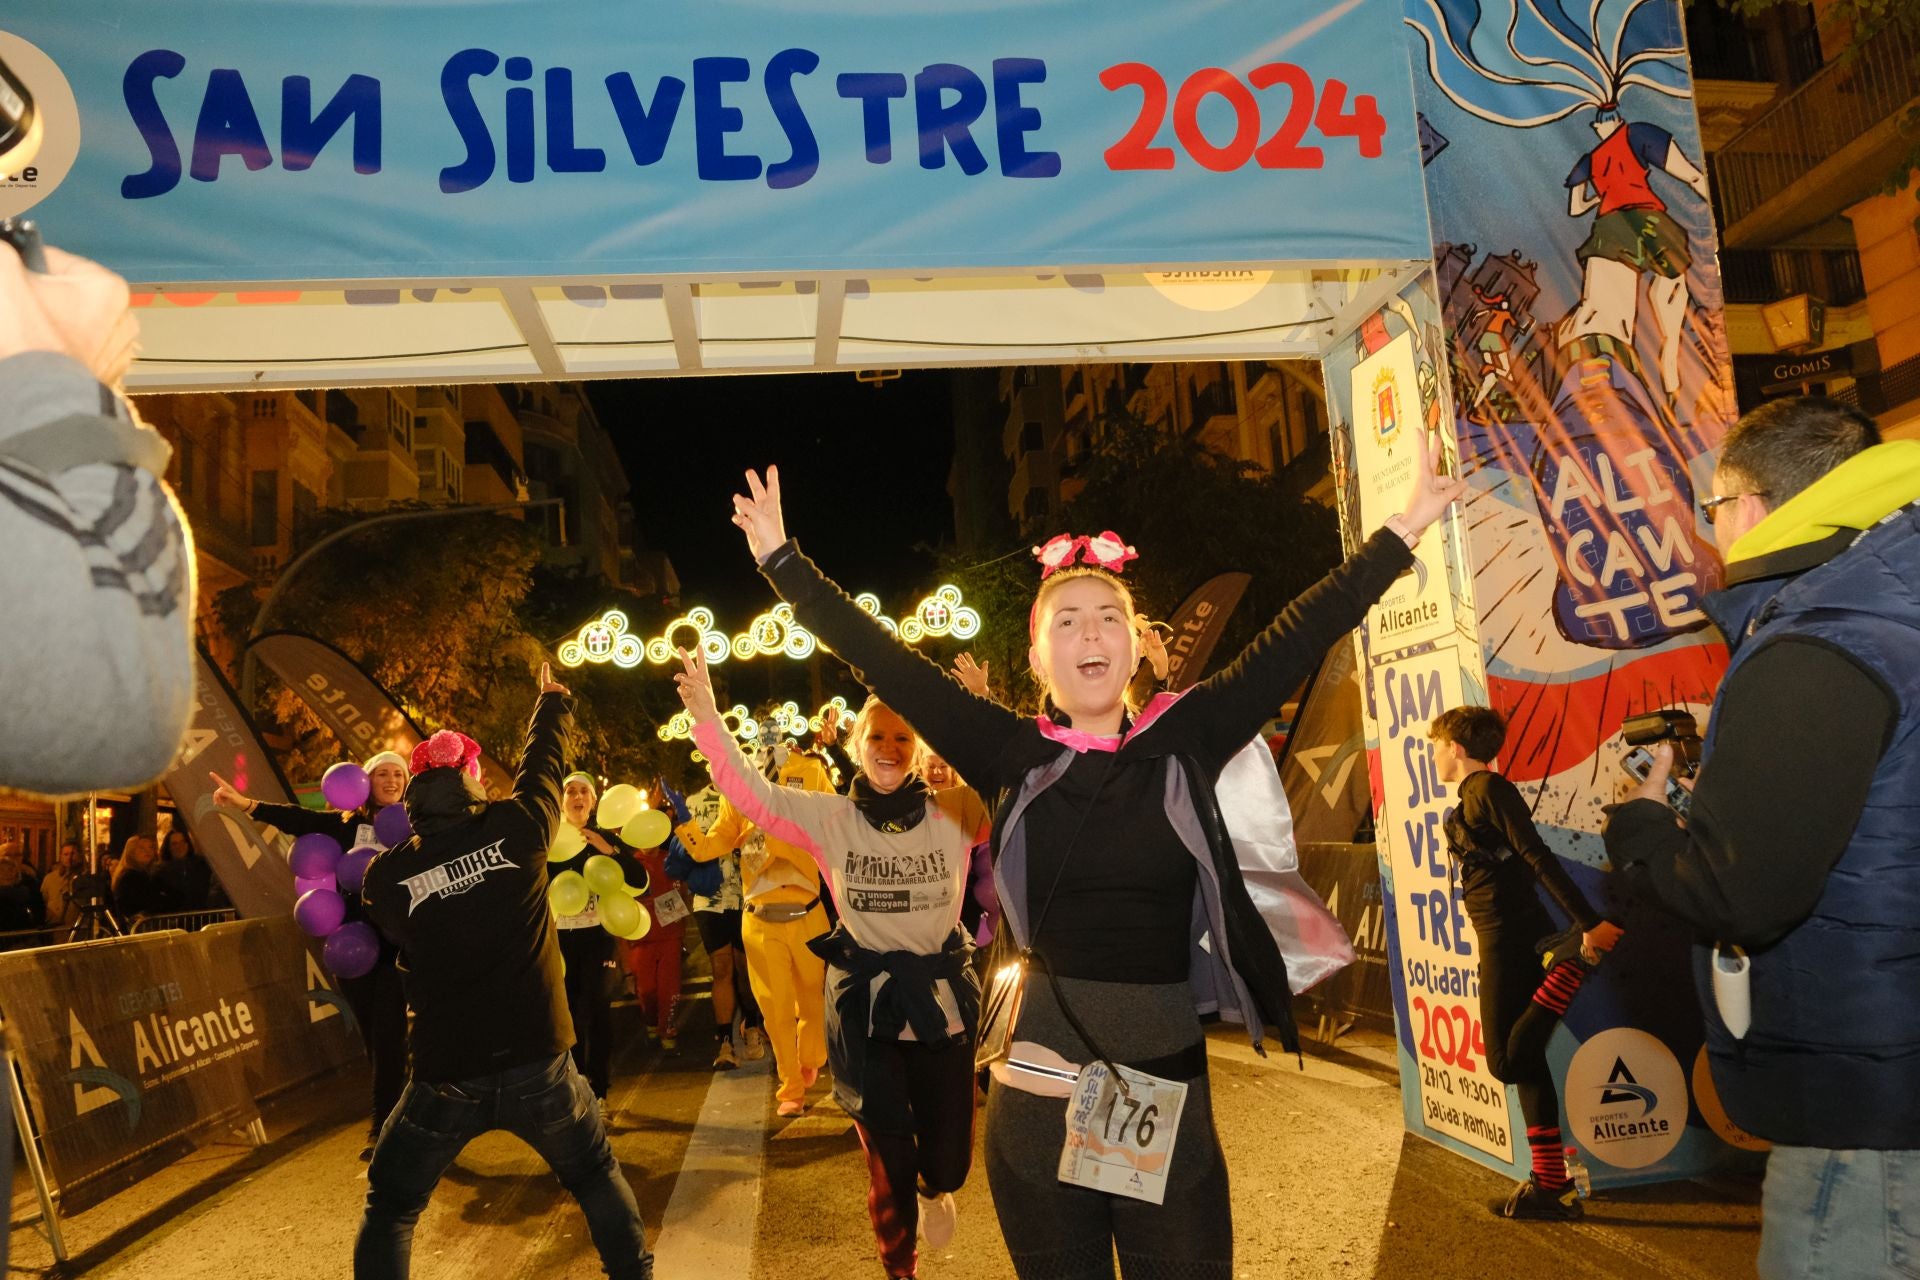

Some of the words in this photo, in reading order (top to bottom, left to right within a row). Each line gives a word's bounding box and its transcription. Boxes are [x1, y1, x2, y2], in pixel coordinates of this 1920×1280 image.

[120, 49, 382, 200] SAN
[1099, 62, 1386, 173] 2024
[1774, 355, 1831, 379] GOMIS
[1551, 448, 1672, 519] ALI
[1566, 516, 1695, 587] CAN
[1380, 601, 1438, 634] Alicante
[1575, 572, 1708, 641] TE
[1385, 667, 1445, 739] SAN
[868, 899, 909, 908] alcoyana
[878, 877, 896, 886] GRAN
[896, 874, 927, 886] CARRERA
[1410, 886, 1472, 955] TRE
[133, 997, 254, 1075] Alicante
[1422, 1062, 1454, 1095] 27/12
[1459, 1075, 1490, 1106] 19:30
[1104, 1092, 1159, 1148] 176
[1426, 1096, 1462, 1128] Salida:
[1463, 1111, 1507, 1147] Rambla
[1594, 1118, 1669, 1140] Alicante
